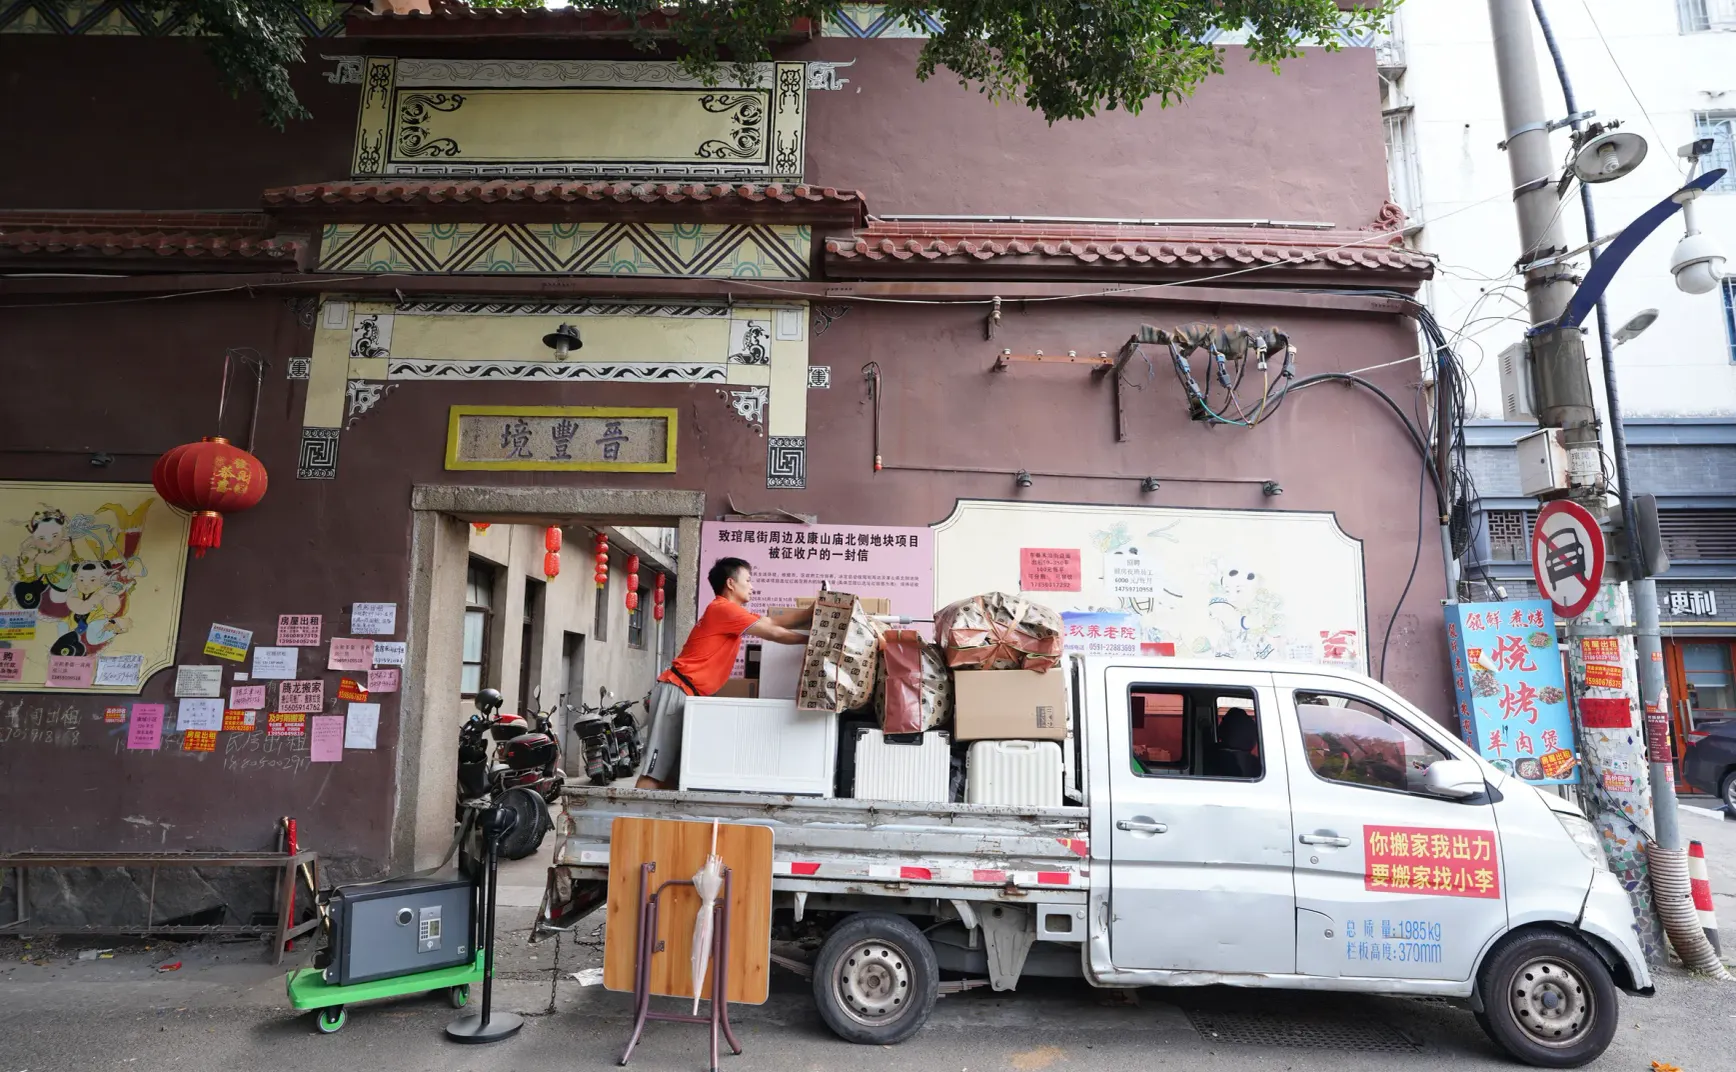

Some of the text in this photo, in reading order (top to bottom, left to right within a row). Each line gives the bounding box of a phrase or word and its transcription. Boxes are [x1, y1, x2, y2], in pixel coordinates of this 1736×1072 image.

[718, 530, 919, 549] 致琯尾街周边及康山庙北侧地块项目
[768, 547, 869, 562] 被征收户的一封信
[280, 616, 319, 625] 房屋出租
[1064, 625, 1136, 640] 玖养老院
[282, 682, 322, 694] 腾龙搬家
[1491, 634, 1541, 725] 烧烤
[1487, 729, 1564, 758] 羊肉煲
[1370, 831, 1490, 860] 你搬家我出力
[1371, 864, 1494, 893] 要搬家找小李
